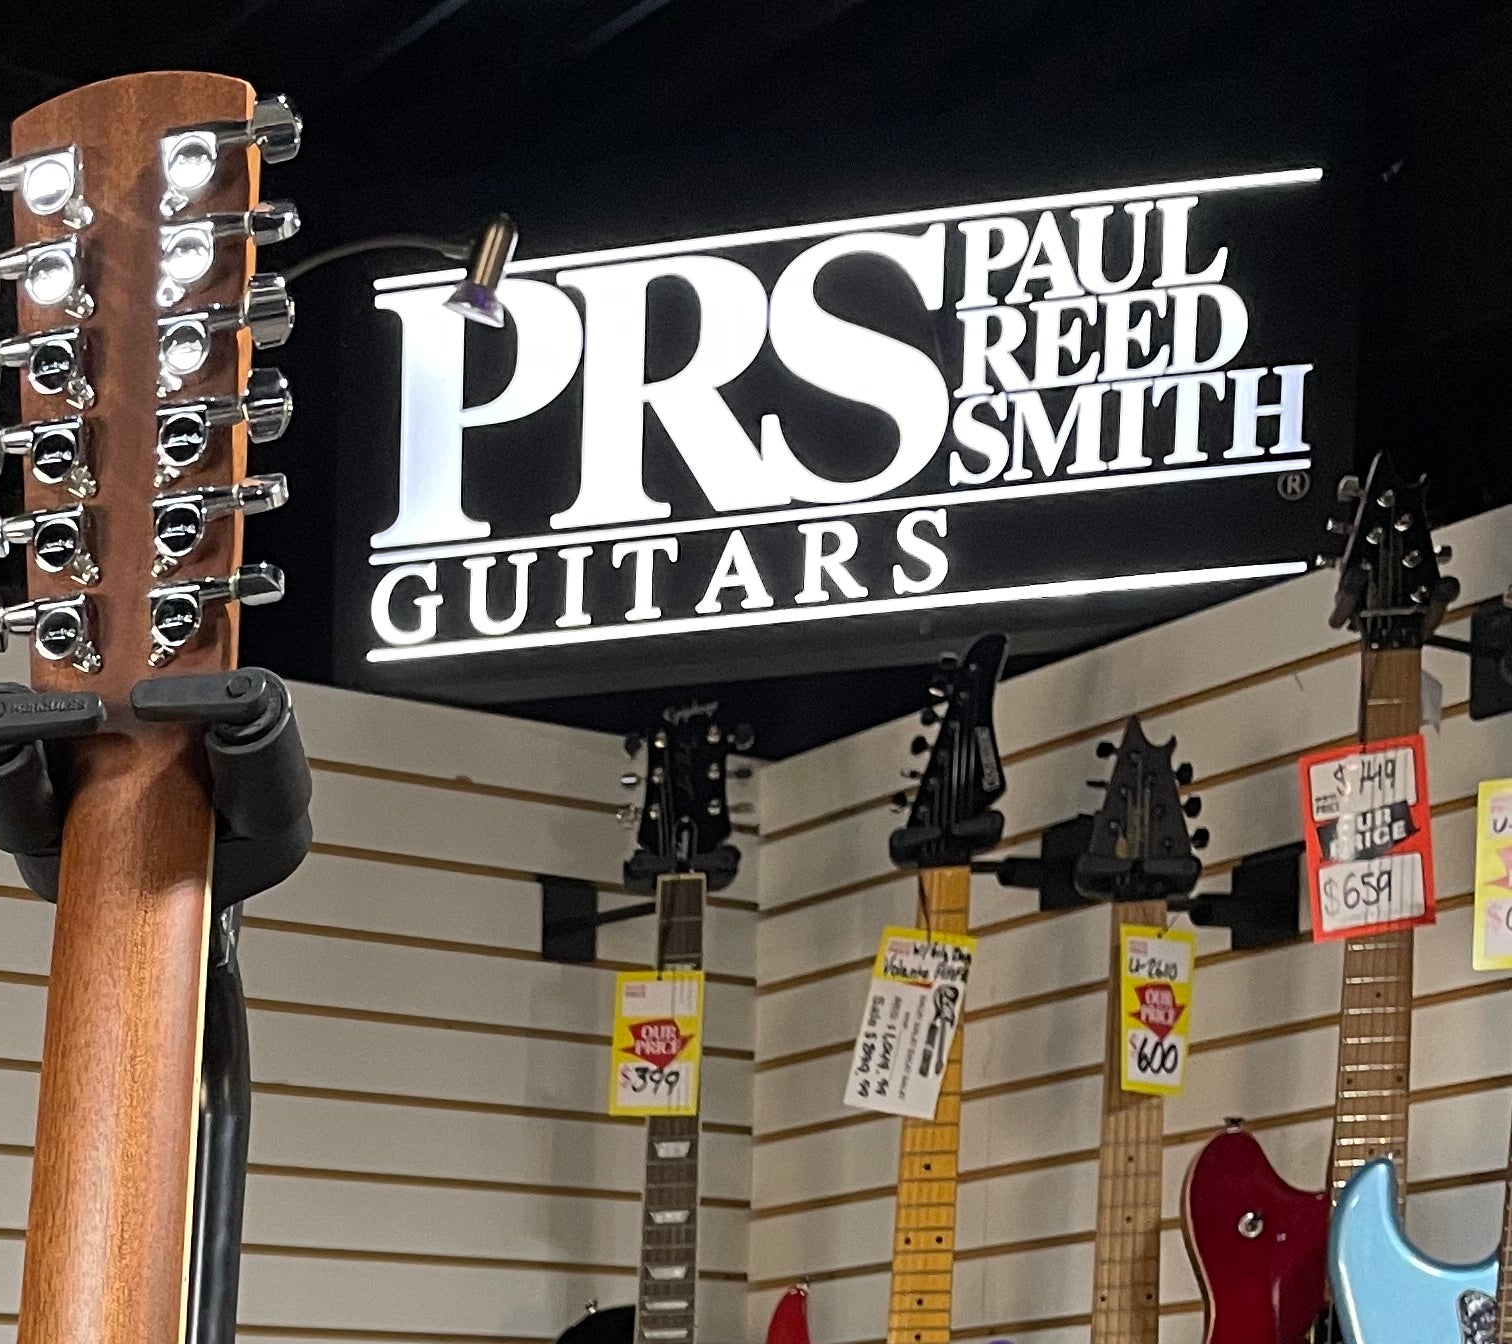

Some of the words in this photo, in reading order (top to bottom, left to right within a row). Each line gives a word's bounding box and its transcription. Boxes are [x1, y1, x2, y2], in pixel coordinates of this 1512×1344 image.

[955, 196, 1229, 311] PAUL
[370, 222, 951, 549] PRS
[952, 286, 1250, 399] REED
[949, 363, 1314, 490] SMITH
[370, 506, 952, 648] GUITARS
[1324, 870, 1393, 917] $659
[1330, 819, 1408, 858] ICE
